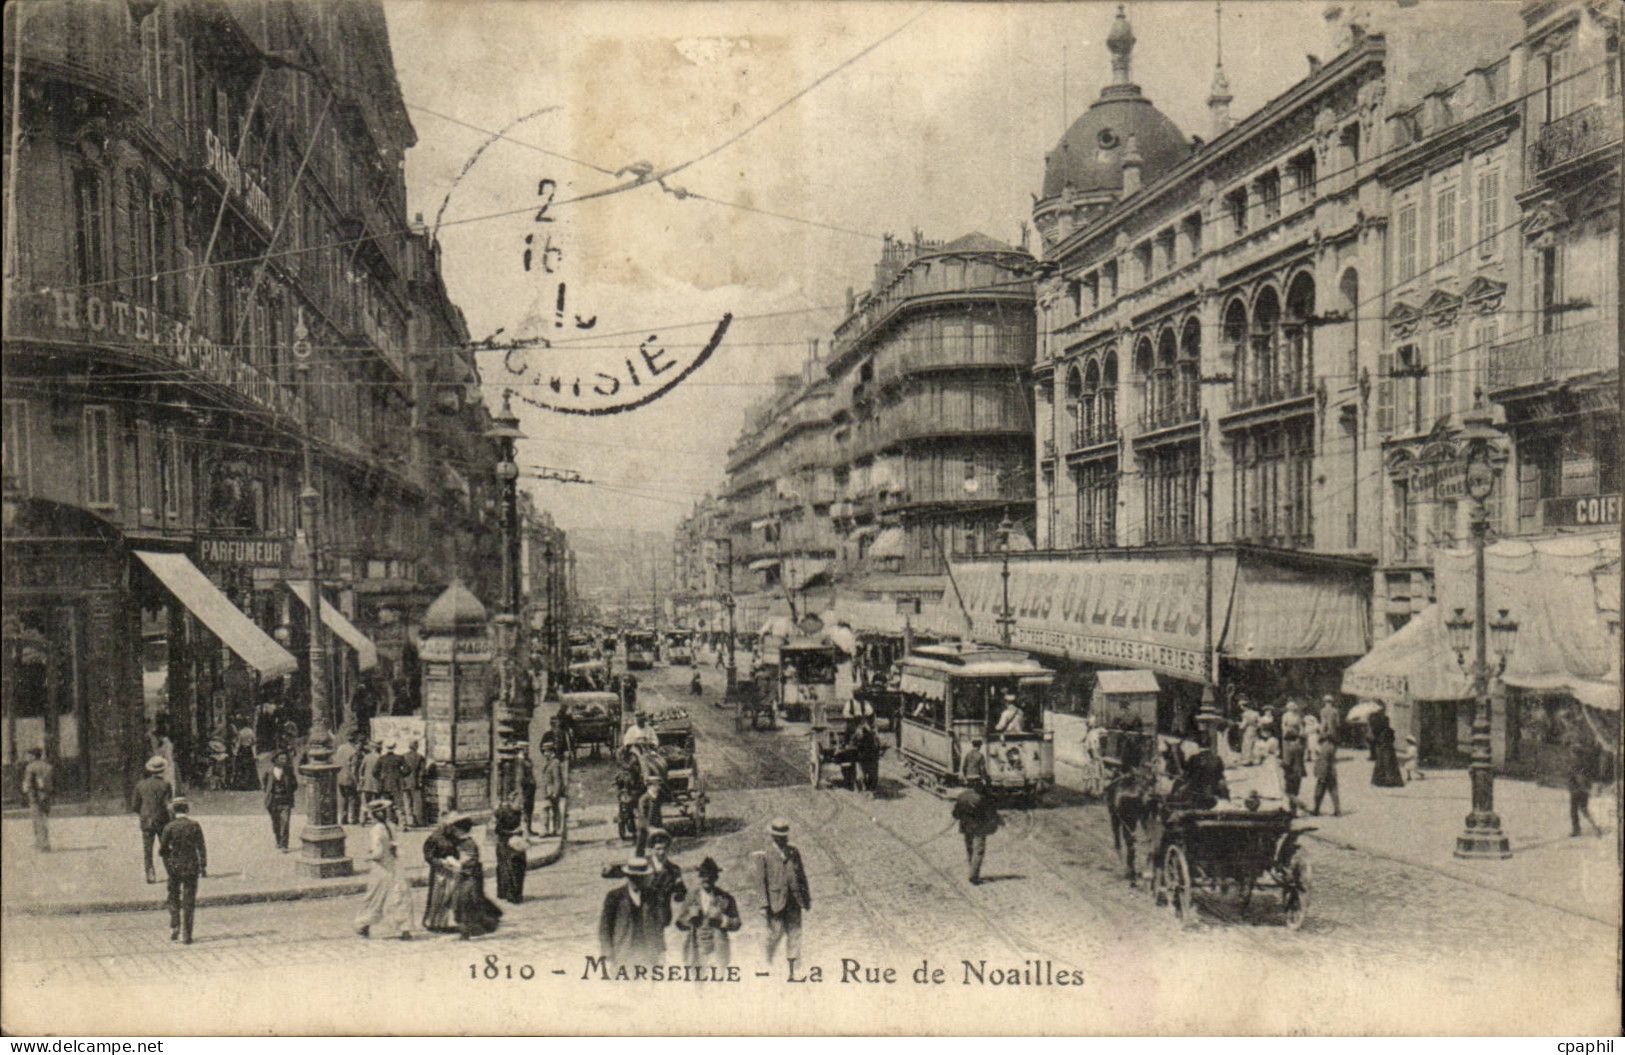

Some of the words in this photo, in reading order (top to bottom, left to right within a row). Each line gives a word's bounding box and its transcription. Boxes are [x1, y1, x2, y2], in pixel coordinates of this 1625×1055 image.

[52, 290, 160, 347] HOTEL
[201, 541, 282, 562] PARFUMEUR
[1075, 636, 1134, 660] NOUVELLES
[1138, 644, 1196, 671] GALERIES
